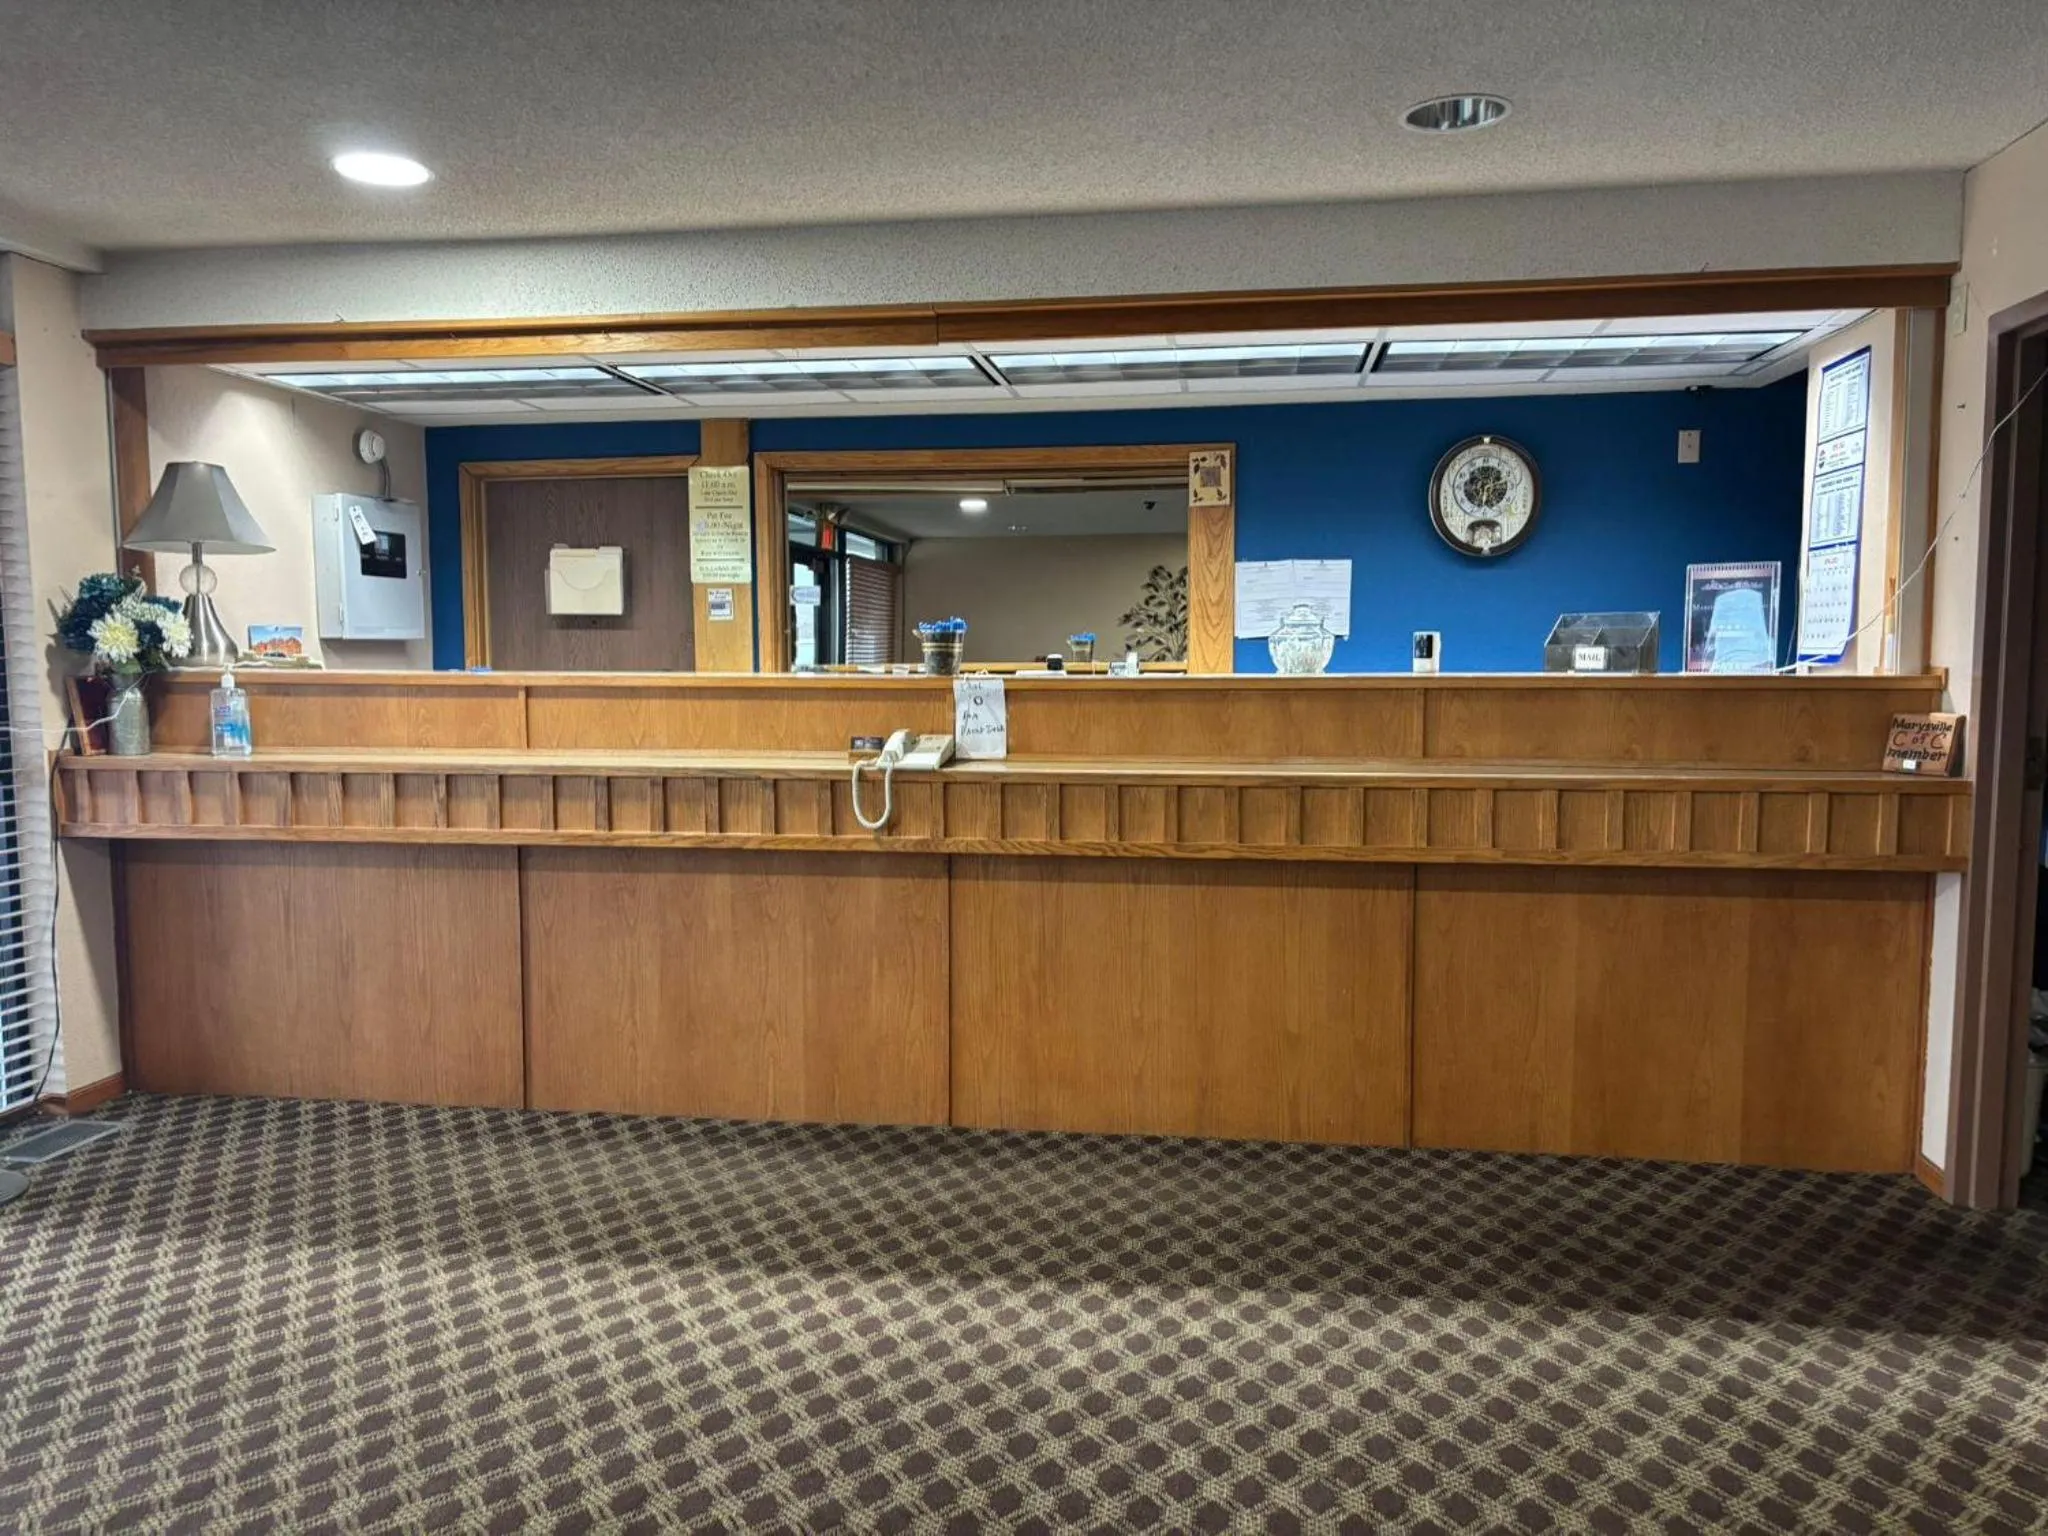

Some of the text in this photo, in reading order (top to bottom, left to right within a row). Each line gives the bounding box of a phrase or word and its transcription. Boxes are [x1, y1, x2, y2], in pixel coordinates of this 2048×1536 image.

[1892, 717, 1953, 734] Marysville
[1892, 730, 1908, 747] C
[1930, 732, 1947, 749] C
[1886, 747, 1949, 762] member
